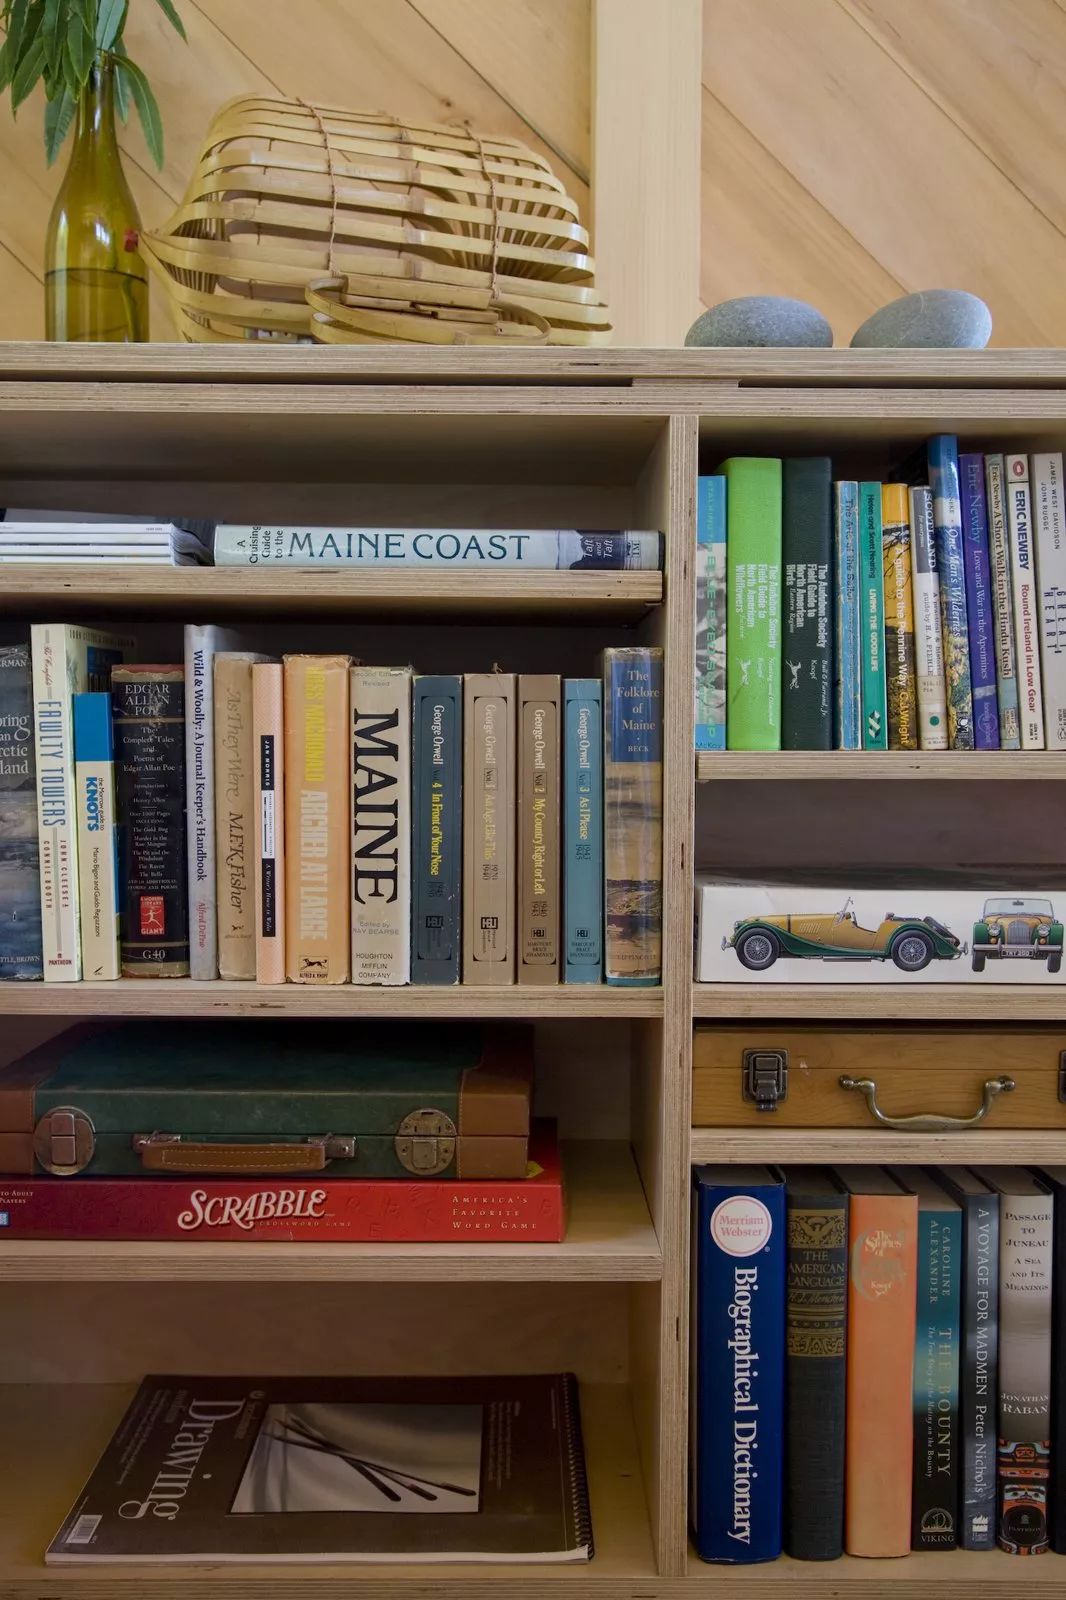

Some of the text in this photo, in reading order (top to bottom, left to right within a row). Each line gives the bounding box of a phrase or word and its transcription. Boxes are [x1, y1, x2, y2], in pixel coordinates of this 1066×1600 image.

[967, 464, 982, 492] Eric
[968, 494, 984, 544] Newby
[1016, 490, 1027, 520] ERIC
[262, 530, 271, 558] Guide
[924, 491, 937, 568] SCOTLAND
[995, 520, 1004, 548] Short
[250, 526, 261, 564] Cruising
[275, 530, 284, 559] to the
[288, 532, 530, 560] MAINE COAST
[1017, 522, 1029, 570] NEWBY
[786, 564, 796, 586] Birds
[808, 564, 817, 584] Field
[973, 550, 983, 572] Love
[996, 550, 1006, 578] Walk
[736, 564, 746, 614] Wildflowers
[796, 564, 806, 627] North American
[945, 528, 962, 642] One Man's Wilderness
[975, 573, 984, 592] and
[998, 579, 1006, 589] in
[816, 564, 828, 648] The Society
[975, 594, 985, 608] War
[998, 590, 1008, 610] the
[1021, 584, 1030, 616] Round
[869, 588, 878, 672] LIVING THE GOOD LIFE
[894, 558, 906, 686] guide to the Pennine Way
[978, 618, 987, 634] the
[1000, 611, 1010, 646] Hindu
[1044, 592, 1056, 649] HEART
[1022, 618, 1032, 653] Ireland
[0, 659, 27, 668] RMAN
[193, 650, 204, 678] Wild
[977, 636, 989, 680] Apennines
[1002, 648, 1011, 677] Kush
[1025, 655, 1033, 664] in
[124, 684, 170, 694] EDGAR
[627, 670, 649, 681] The
[1026, 666, 1034, 686] Low
[125, 696, 170, 706] ALLAN
[616, 686, 660, 697] Folklore
[1027, 689, 1036, 713] Gear
[134, 706, 160, 716] POE
[192, 688, 205, 731] Woolly:
[632, 703, 643, 714] of
[196, 732, 205, 741] A
[484, 704, 496, 764] George Orwell
[622, 720, 656, 731] Maine
[38, 700, 66, 826] FAWLTY TOWERS
[123, 764, 142, 773] Edgar
[162, 764, 176, 772] Poe
[194, 742, 206, 782] Journal
[577, 708, 590, 840] George Orwell As Please
[226, 752, 245, 805] Were
[430, 705, 444, 876] George Orwell In Front of Your Nose
[86, 777, 99, 832] KNOTS
[194, 782, 207, 826] Keeper's
[354, 708, 399, 905] MAINE
[532, 709, 546, 895] George Orwell My Country Right or Left
[196, 828, 208, 882] Handbook
[300, 790, 328, 941] ARCHER AT LARGE
[229, 863, 248, 914] Fisher
[177, 1189, 326, 1230] SCRABBLE
[452, 1196, 528, 1204] AMERICA'S
[719, 1215, 764, 1225] Merriam
[1005, 1212, 1052, 1222] PASSAGE
[720, 1227, 762, 1237] Webster
[1005, 1240, 1049, 1248] JUNEAU
[788, 1263, 845, 1274] AMERICAN
[802, 1251, 828, 1261] THE
[928, 1220, 940, 1304] ALEXANDER
[942, 1226, 952, 1297] CAROLINE
[1005, 1284, 1049, 1292] MEANINGS
[974, 1208, 990, 1494] A VOYAGE FOR MADMEN Peter Nichols
[727, 1266, 759, 1545] Biographical Dictionary
[937, 1328, 952, 1478] THE BOUNTY
[1000, 1393, 1049, 1402] JONATHAN
[1003, 1404, 1048, 1414] RABAN
[924, 1400, 934, 1478] Mutiny Bounty
[118, 1398, 246, 1521] Drawing
[920, 1534, 954, 1544] VIKING
